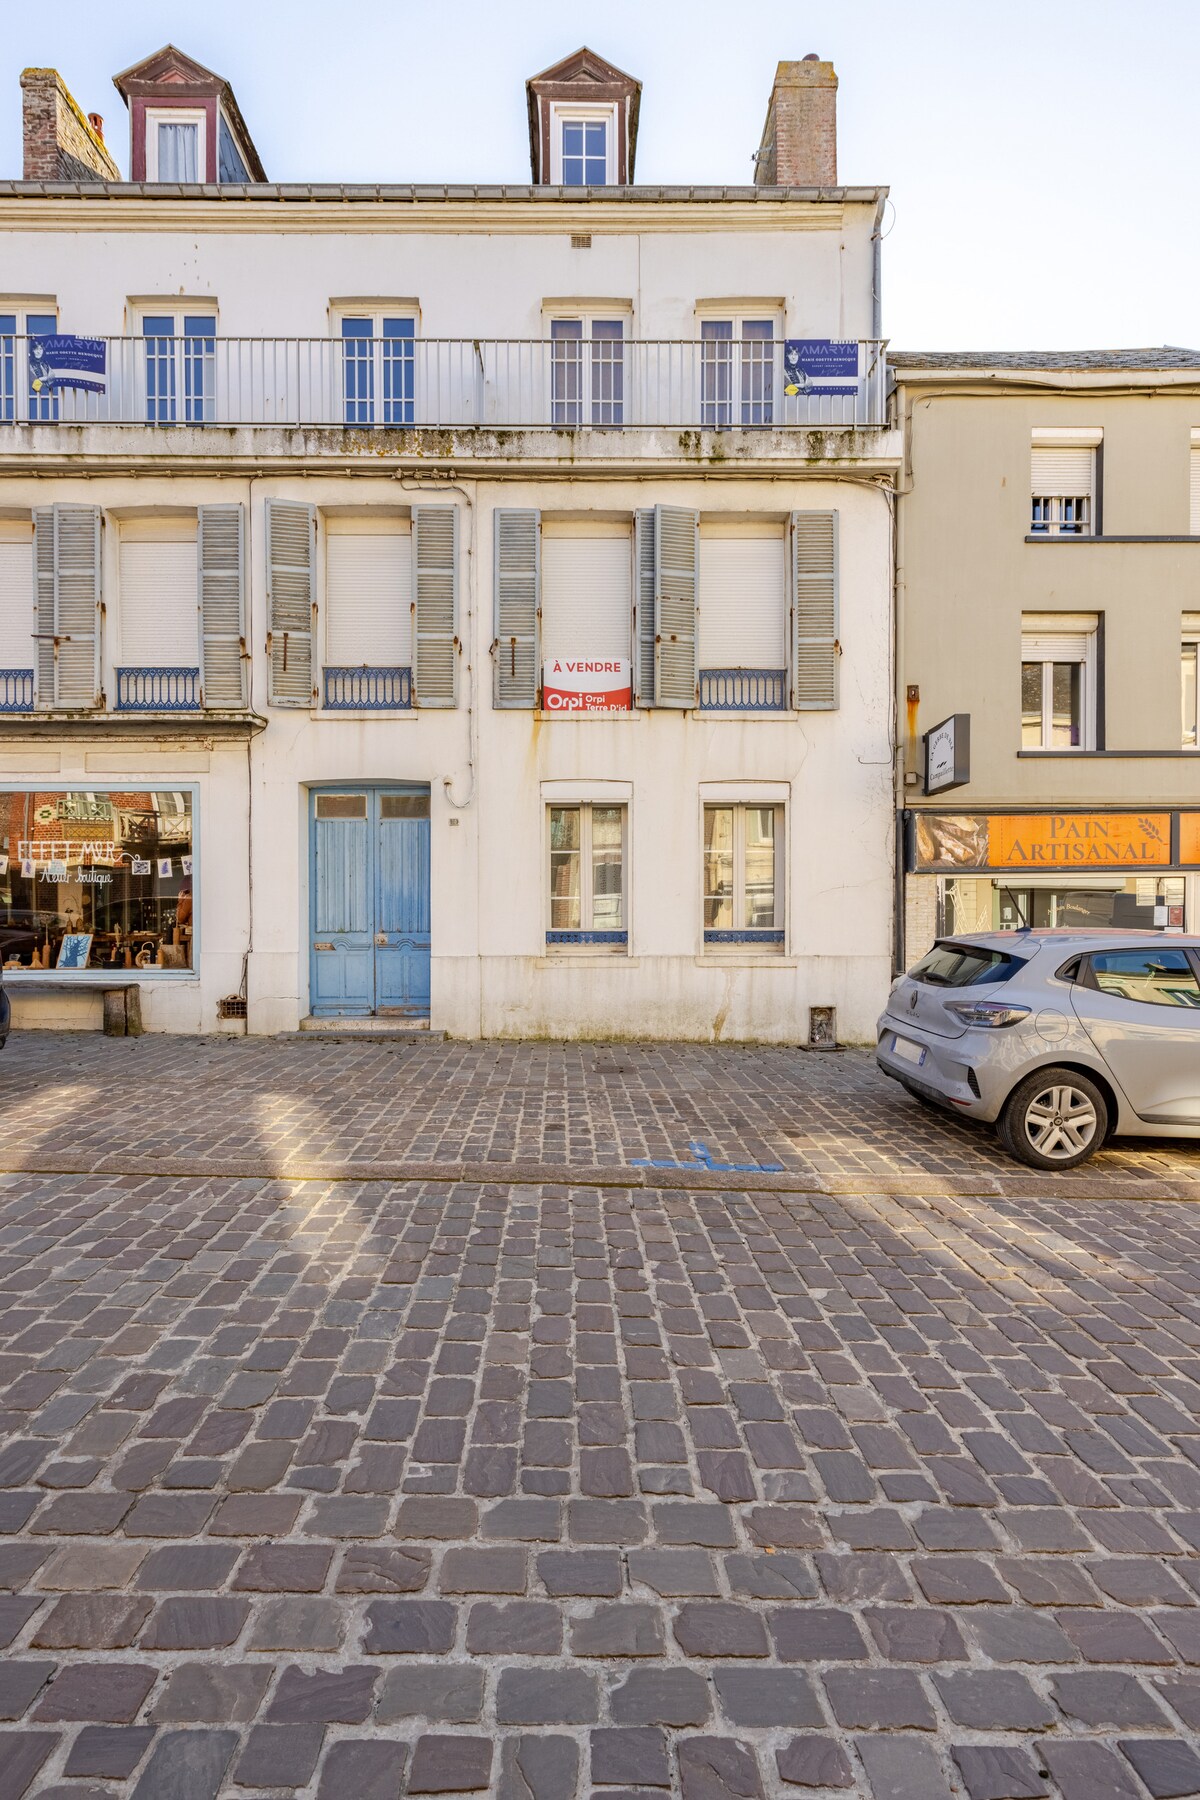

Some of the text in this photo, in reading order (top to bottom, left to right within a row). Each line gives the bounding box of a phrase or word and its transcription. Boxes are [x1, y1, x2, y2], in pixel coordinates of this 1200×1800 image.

[46, 339, 104, 351] AMARYM
[801, 345, 857, 354] AMARYM
[553, 660, 621, 672] À VENDRE
[547, 693, 583, 710] Orpi
[585, 694, 606, 703] Orpi
[1050, 817, 1109, 838] PAIN
[18, 841, 73, 862] EFFET
[1007, 839, 1155, 860] ARTISANAL
[75, 866, 113, 889] boutique
